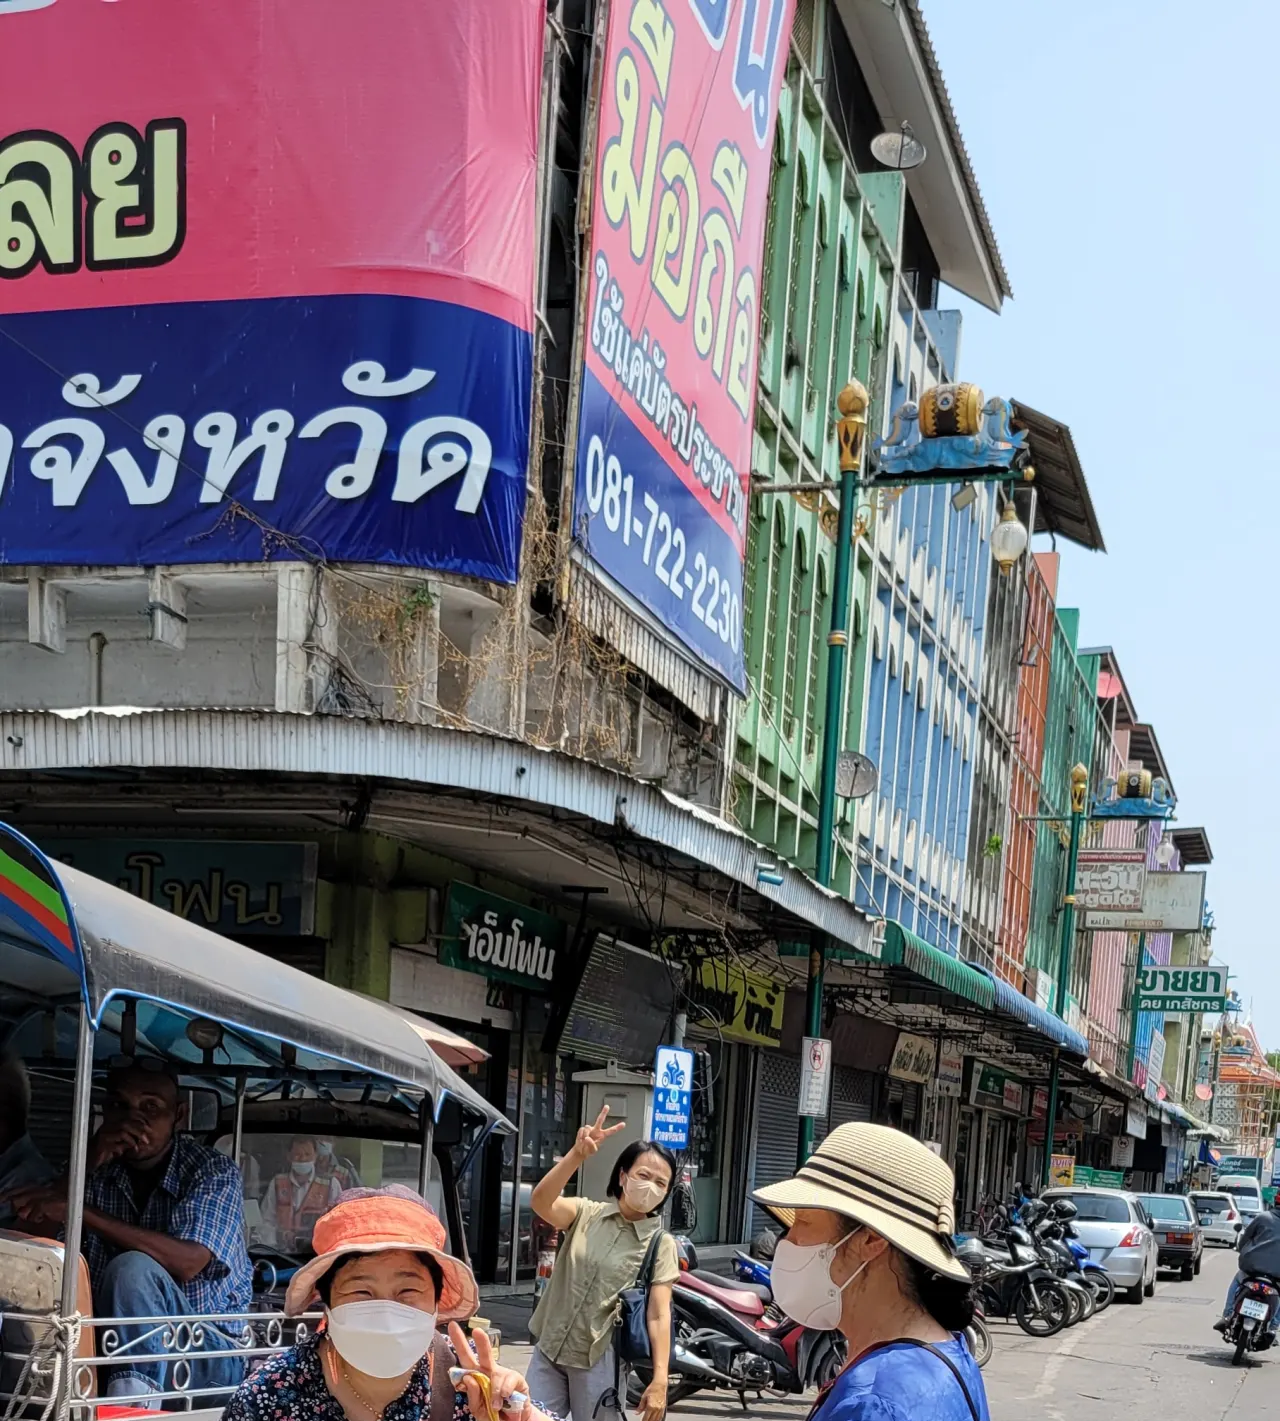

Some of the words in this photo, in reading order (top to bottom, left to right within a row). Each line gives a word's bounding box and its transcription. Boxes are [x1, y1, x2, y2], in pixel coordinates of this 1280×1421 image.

[0, 361, 493, 514] จังหวัด
[585, 434, 740, 655] 081-722-2230
[467, 910, 556, 981] เอ็มโฟน
[1140, 969, 1221, 993] ขายยา
[1139, 995, 1162, 1010] ดย
